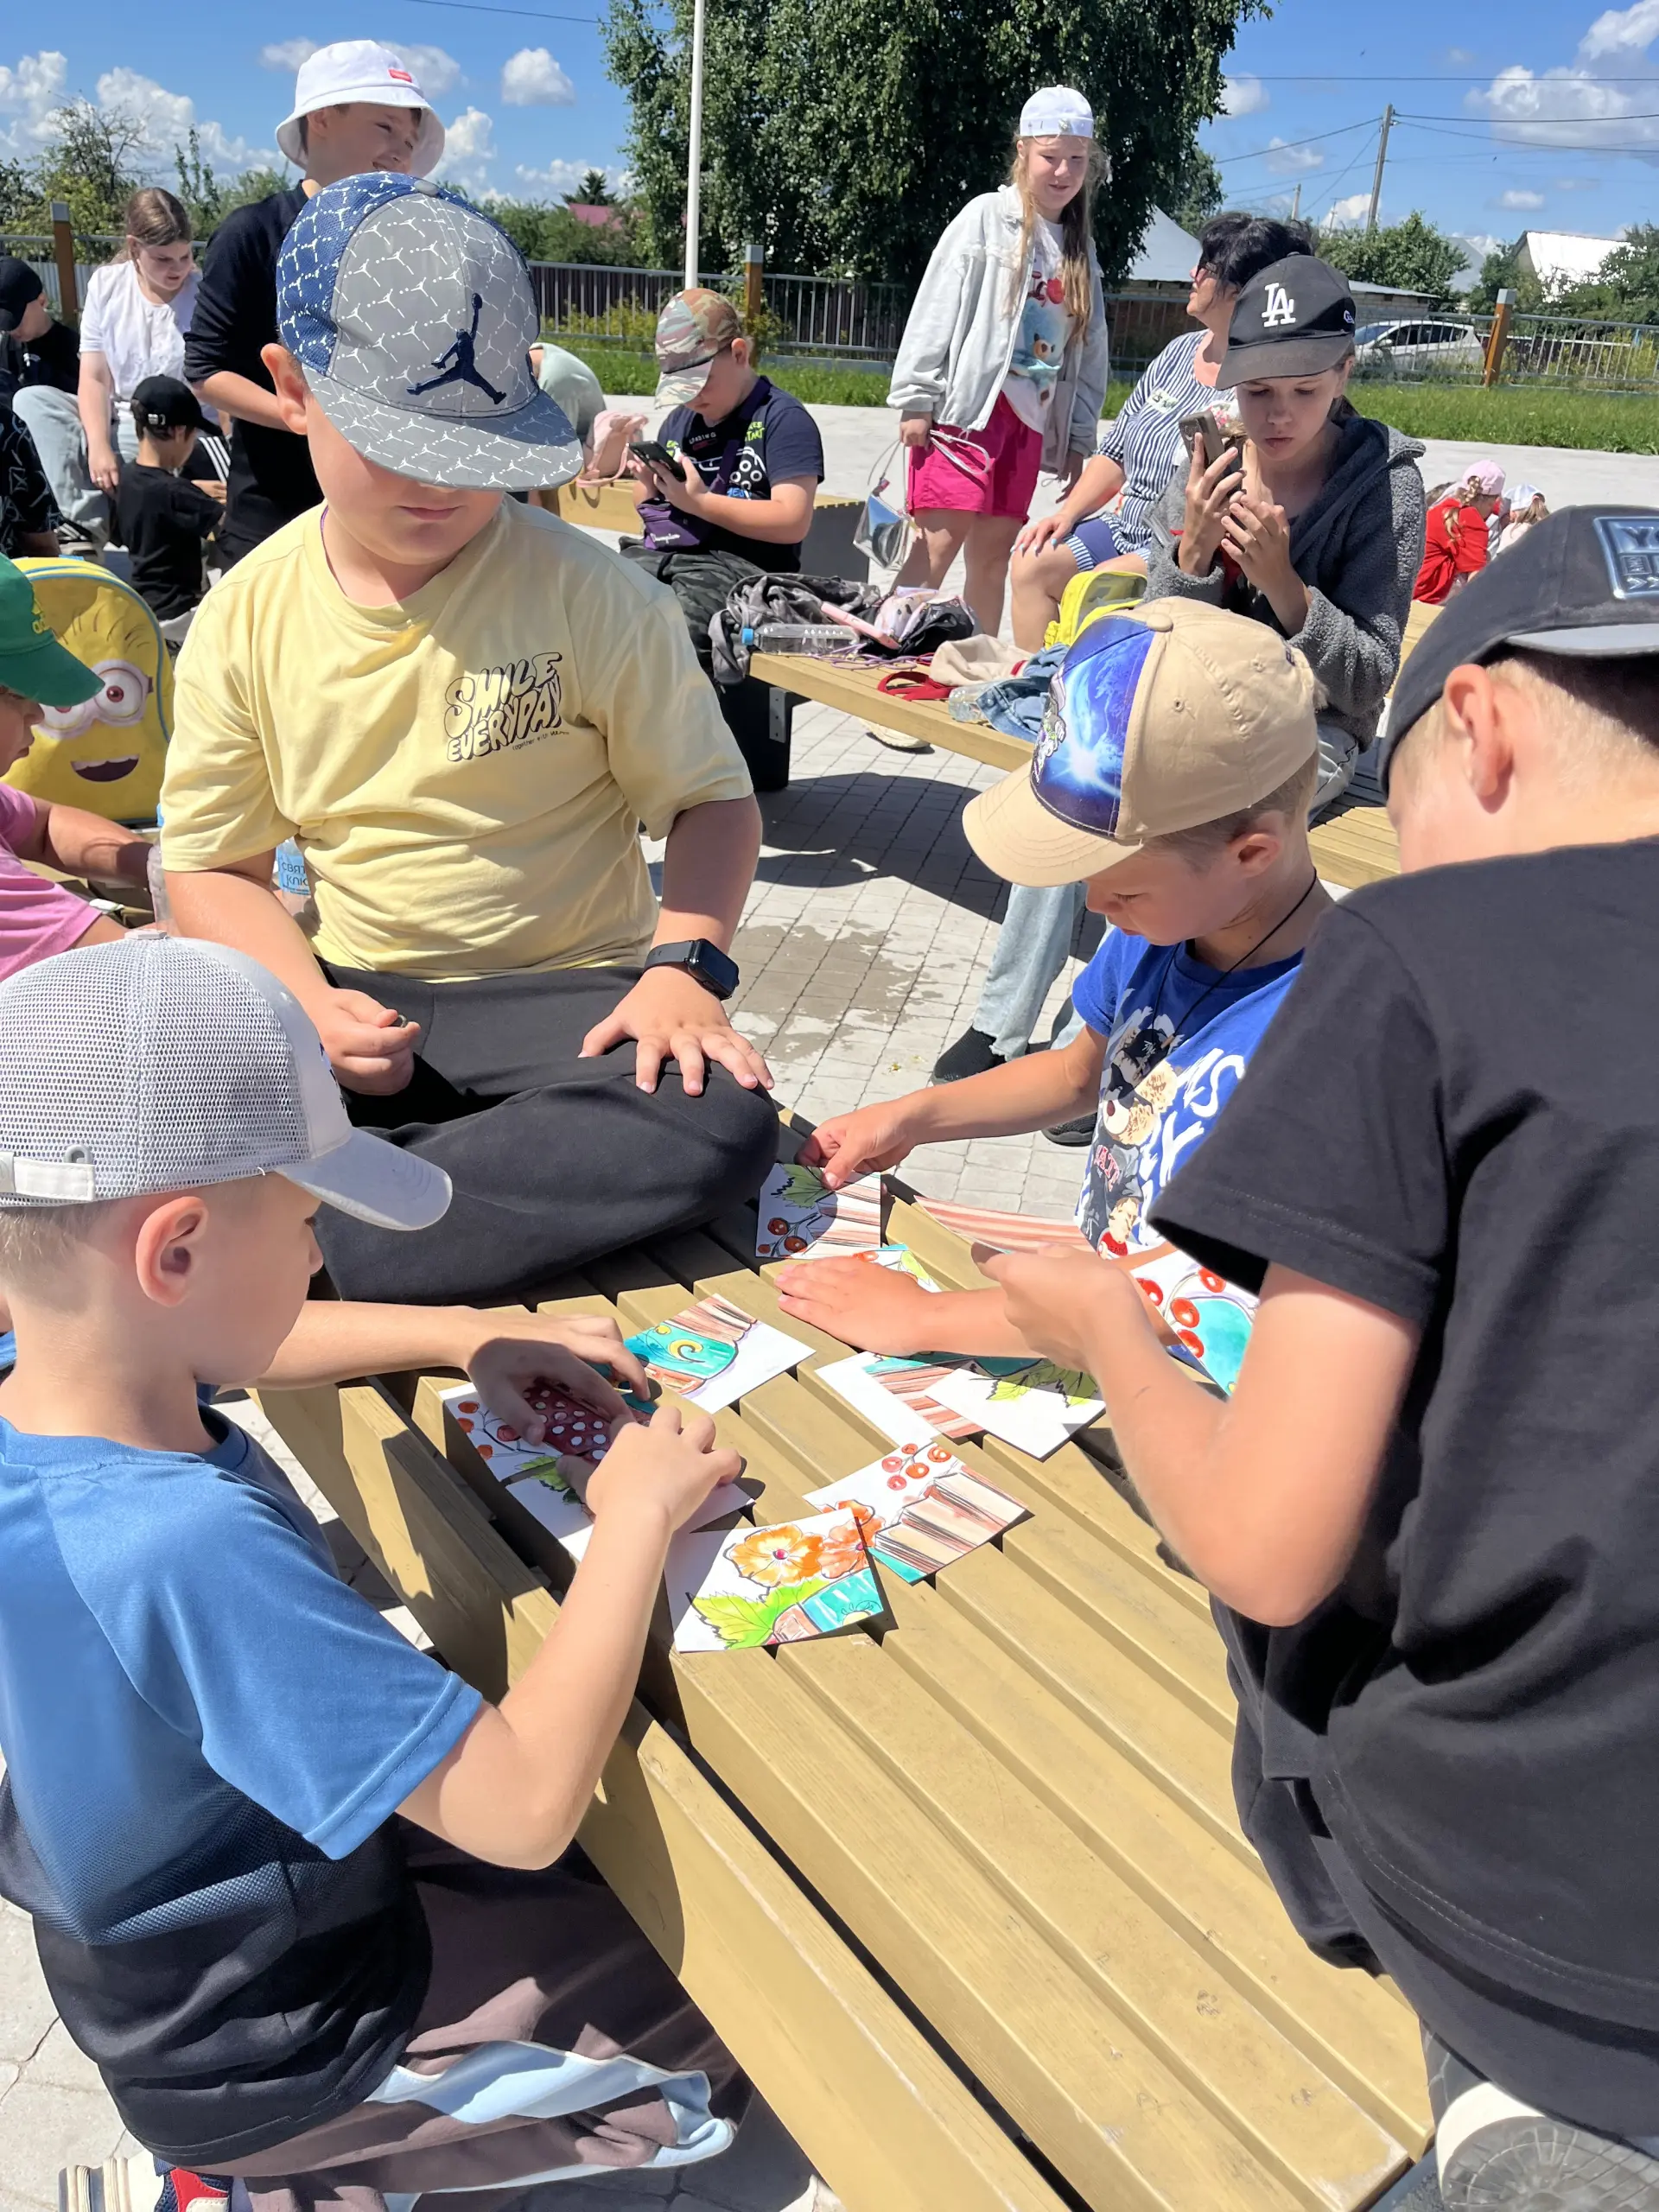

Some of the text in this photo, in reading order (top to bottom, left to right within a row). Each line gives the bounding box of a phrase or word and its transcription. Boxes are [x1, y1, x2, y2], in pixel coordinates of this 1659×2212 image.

[1262, 283, 1296, 327] LA
[444, 652, 563, 739] SMILE
[447, 672, 562, 762] EVERYDAY
